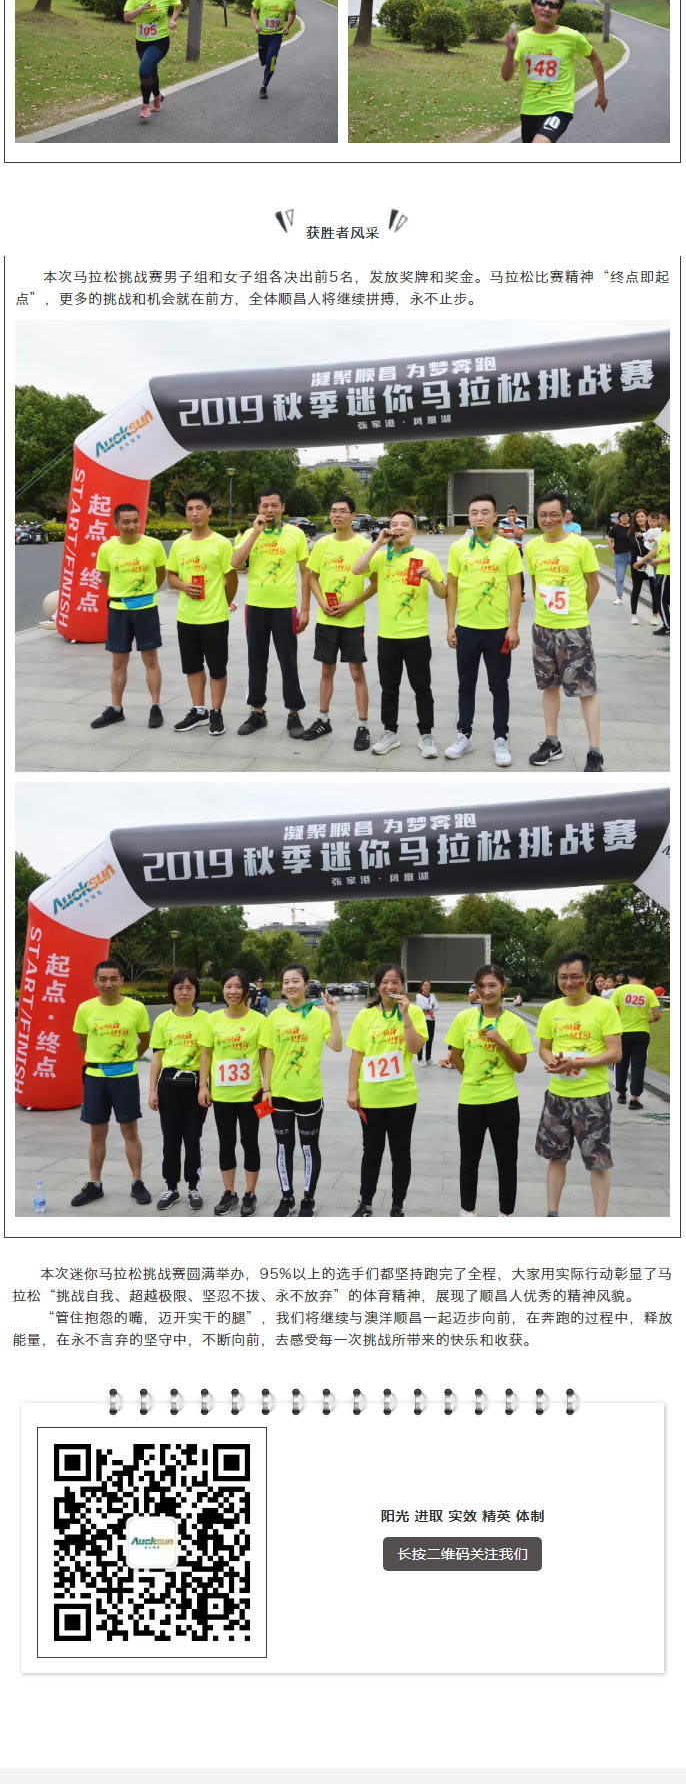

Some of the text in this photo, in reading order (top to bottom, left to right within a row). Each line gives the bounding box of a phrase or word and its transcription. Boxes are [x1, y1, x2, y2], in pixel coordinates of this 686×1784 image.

[138, 23, 157, 37] 105
[264, 18, 281, 28] 139
[525, 58, 558, 78] 148
[310, 356, 497, 387] 凝聚顺昌 为梦奔跑
[95, 409, 155, 458] Aucksun
[283, 813, 477, 841] 凝聚顺昌 为梦奔跑
[52, 863, 116, 916] Aucksun
[625, 993, 646, 1006] 025
[218, 1061, 251, 1082] 133
[367, 1055, 402, 1079] 121
